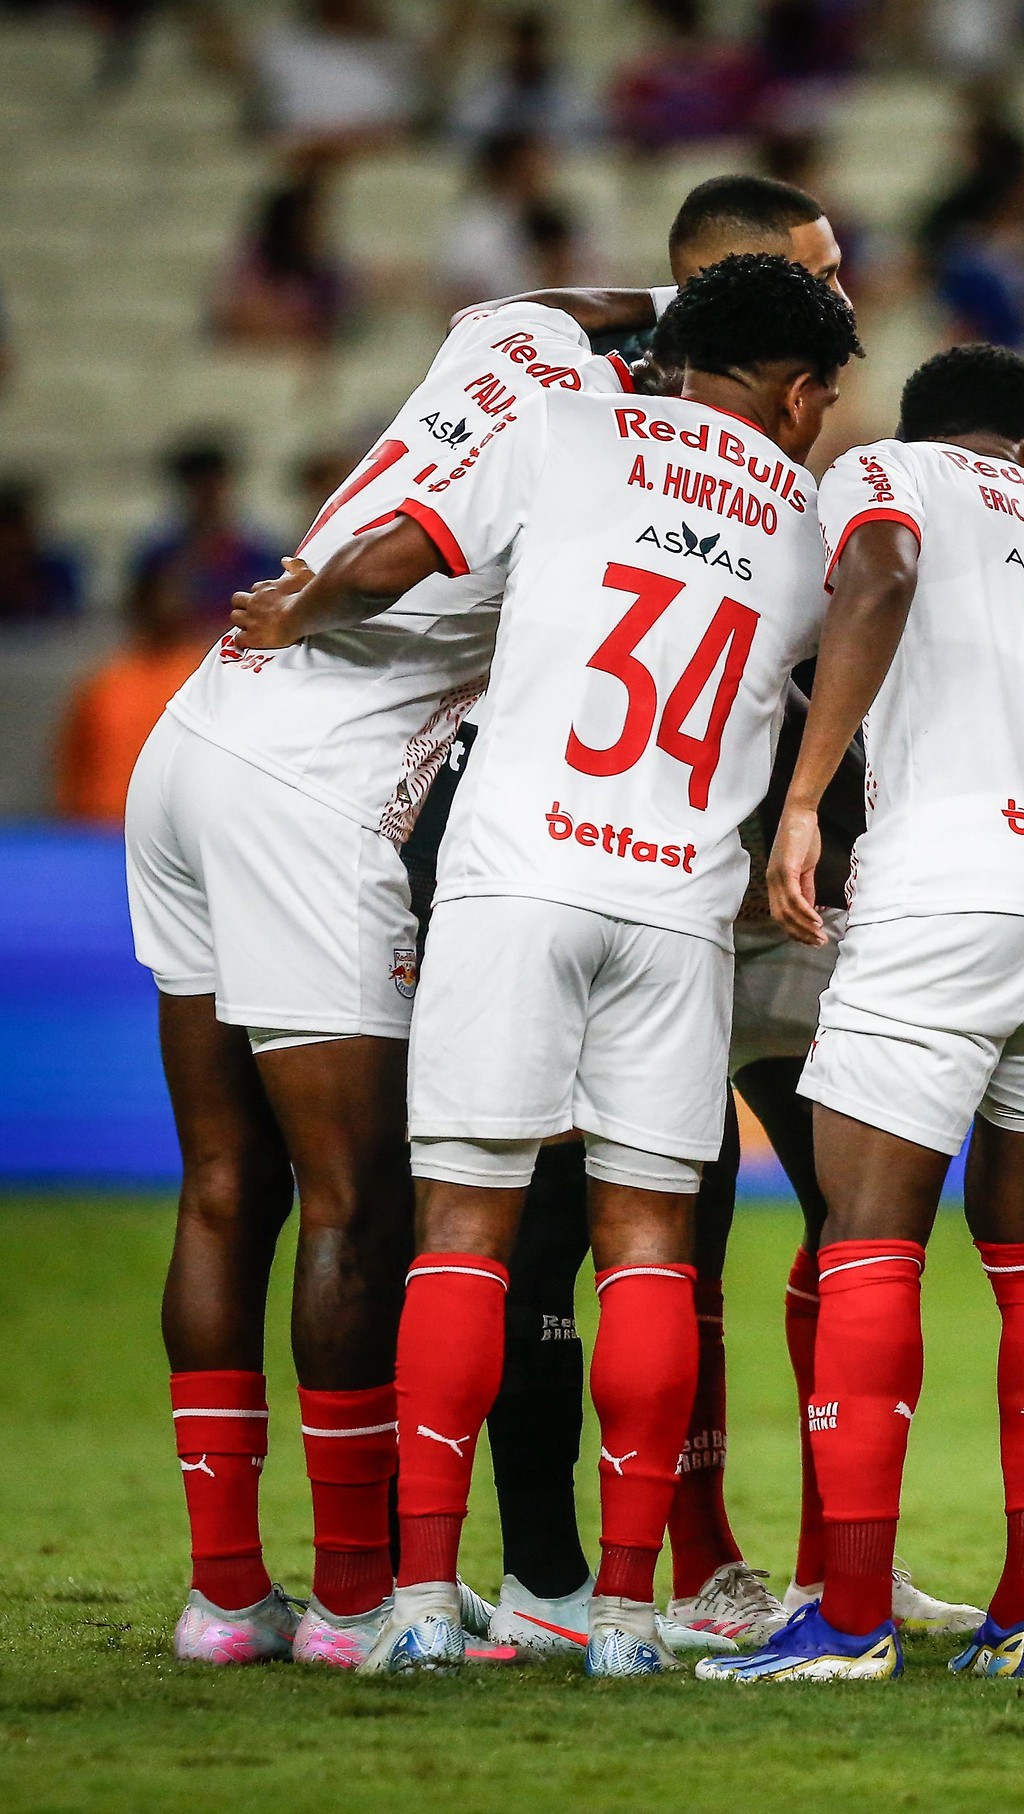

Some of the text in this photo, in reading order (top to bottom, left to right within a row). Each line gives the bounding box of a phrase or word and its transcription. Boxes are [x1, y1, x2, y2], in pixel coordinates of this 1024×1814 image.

[464, 372, 517, 417] PALA
[614, 408, 808, 514] Red Bulls
[627, 454, 778, 535] A. HURTADO
[978, 484, 1024, 522] ERIC
[564, 561, 761, 811] 34
[545, 801, 697, 874] betfast
[807, 1401, 839, 1419] Bull
